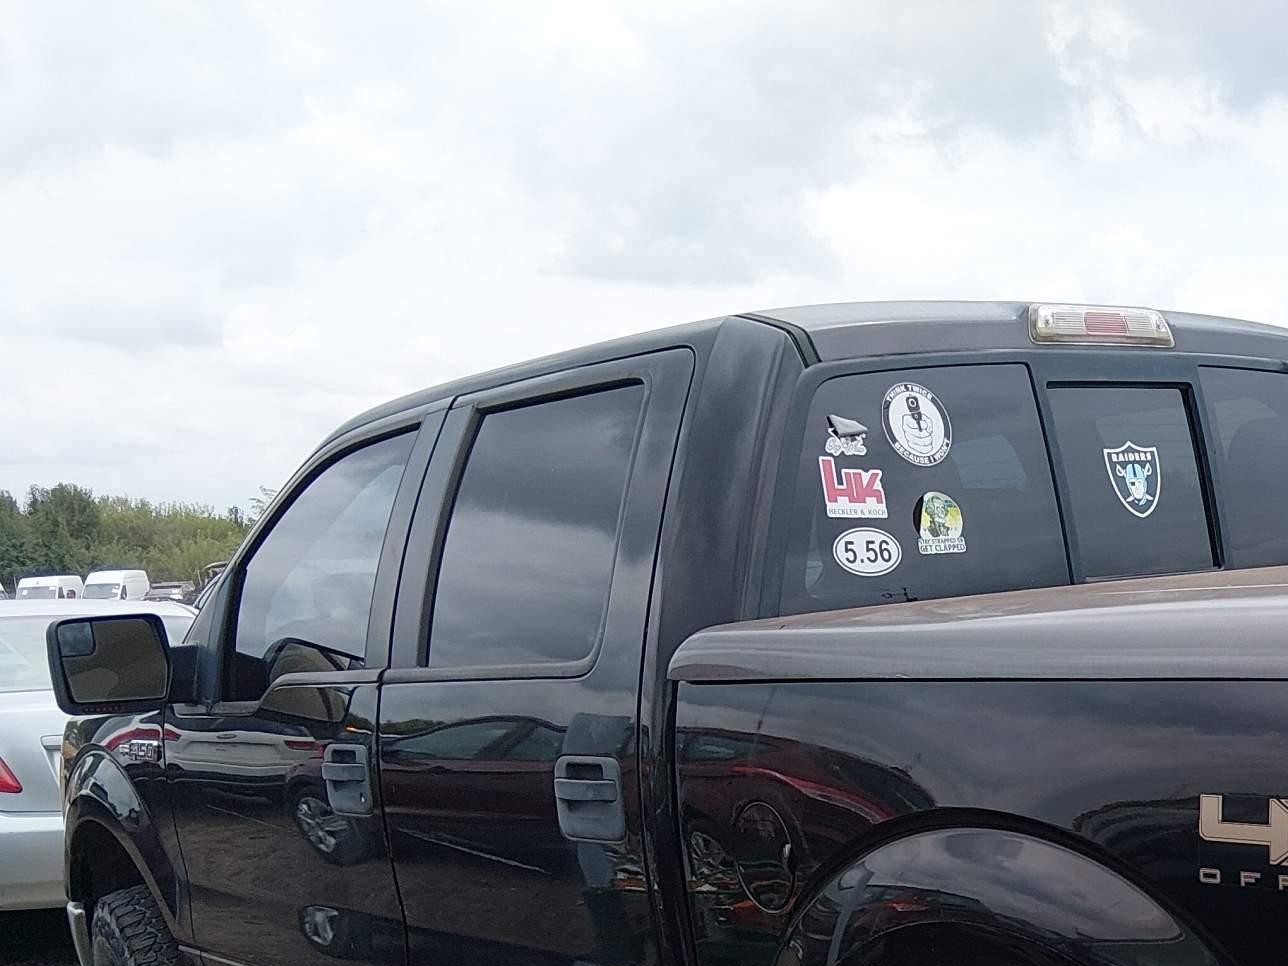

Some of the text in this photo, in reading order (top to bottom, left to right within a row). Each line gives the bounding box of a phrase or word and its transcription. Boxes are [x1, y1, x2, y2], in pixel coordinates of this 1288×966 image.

[886, 384, 933, 402] THINK TWICE
[893, 441, 930, 464] BECAUSE
[1111, 451, 1152, 462] RAIDERS
[821, 458, 884, 505] HK
[828, 508, 858, 516] HECKLER
[868, 508, 886, 516] KOCH
[844, 540, 892, 565] 5.56
[920, 543, 965, 553] GET CLAPPED
